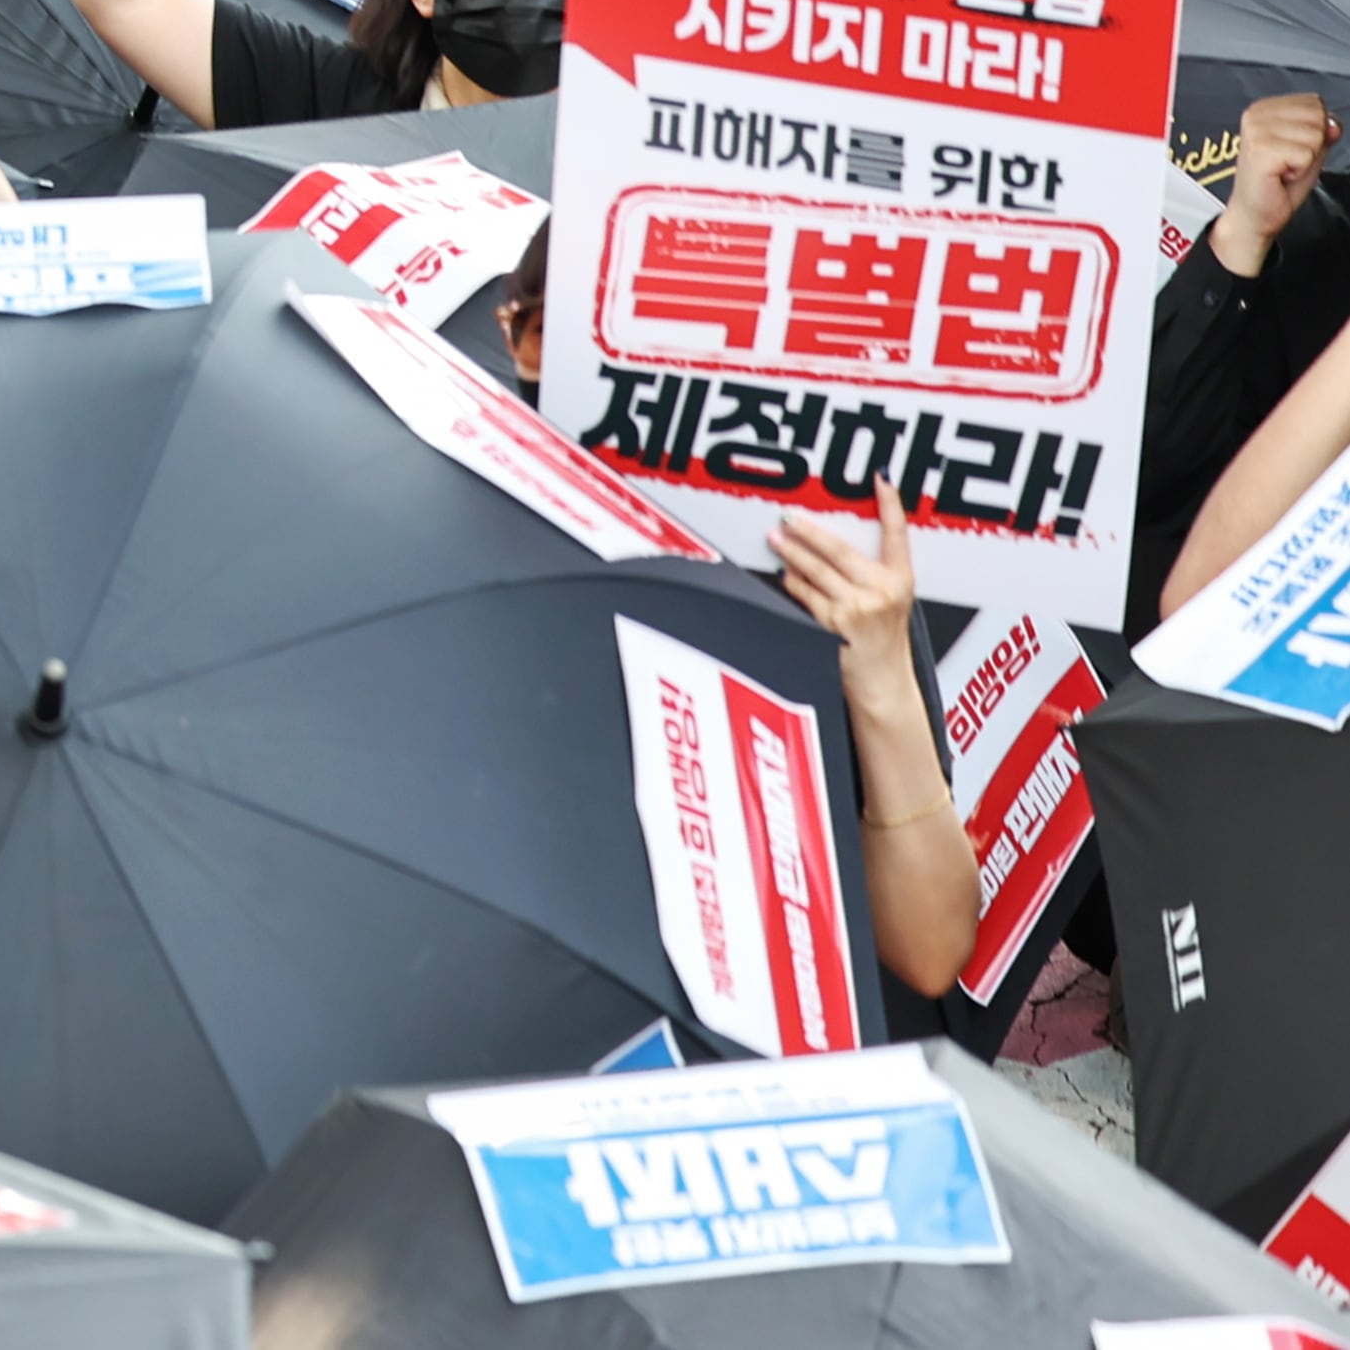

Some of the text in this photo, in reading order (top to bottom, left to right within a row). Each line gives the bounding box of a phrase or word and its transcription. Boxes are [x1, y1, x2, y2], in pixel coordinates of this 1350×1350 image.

[900, 16, 1064, 103] 마라!
[644, 96, 1064, 213] 피해자를 위한
[632, 213, 1083, 378] 특별법
[579, 363, 1104, 538] 제정하라!
[946, 613, 1042, 761] 희생양!
[657, 674, 715, 856] 희생양!
[749, 713, 813, 908] 판매자!
[1163, 899, 1207, 1004] NII
[564, 1120, 894, 1228] 소비자
